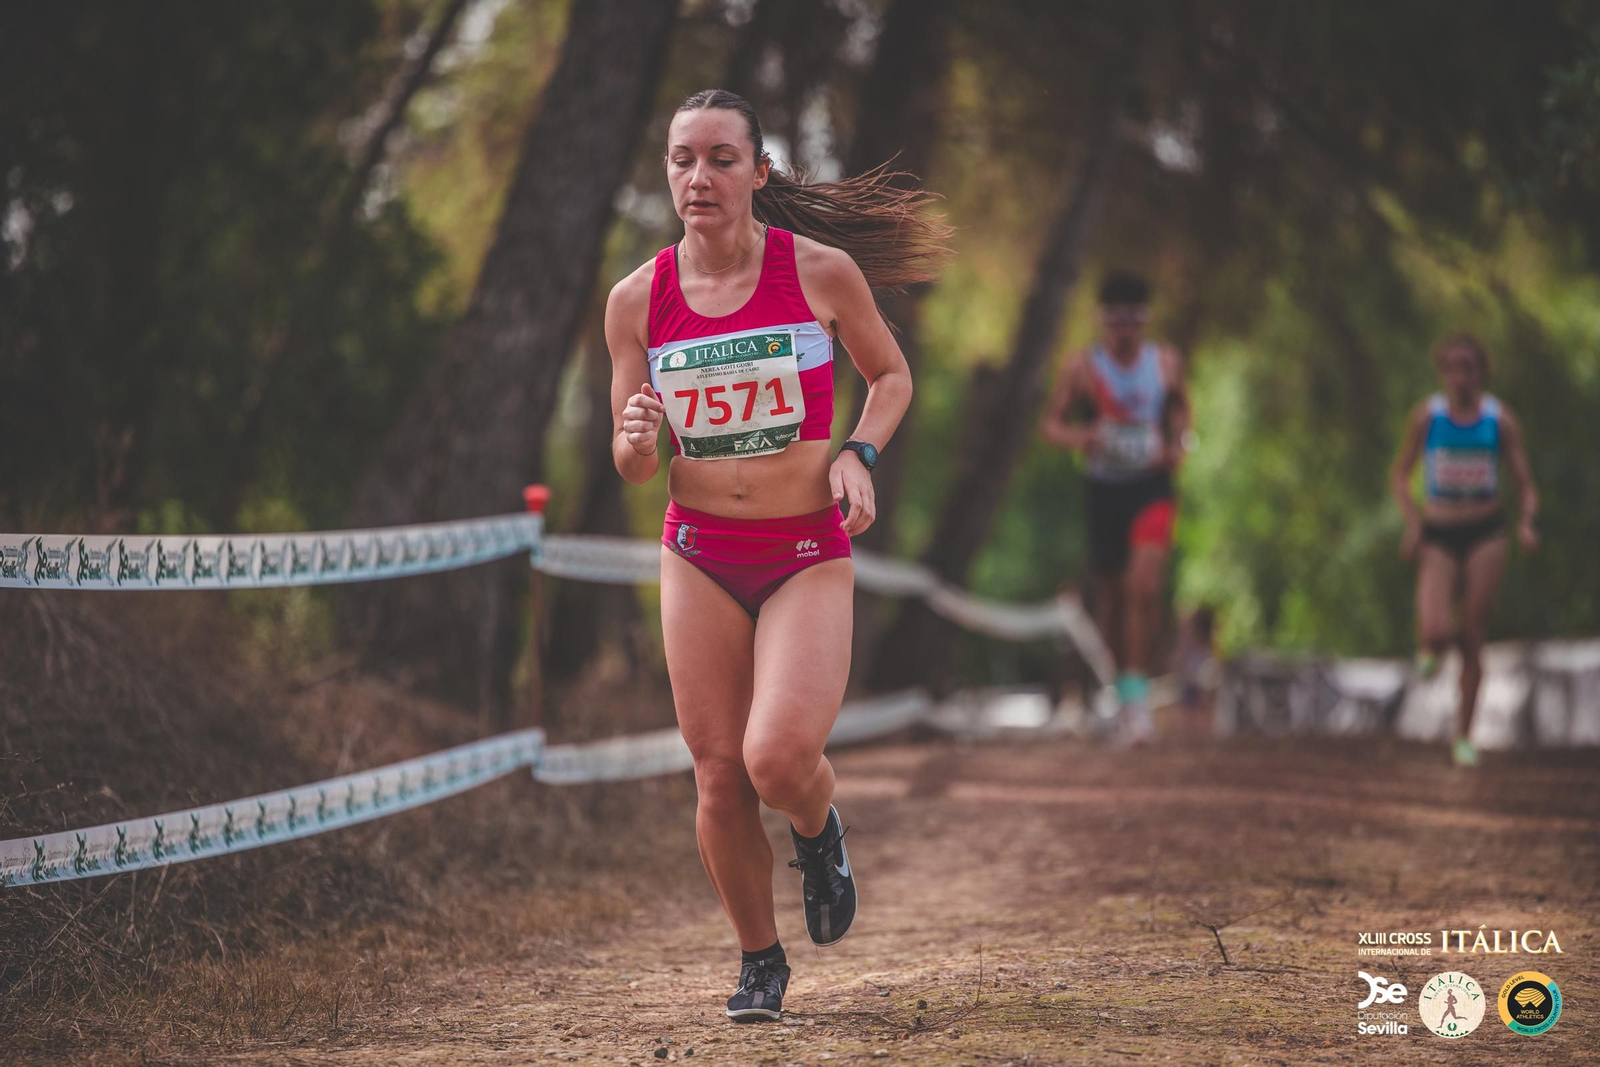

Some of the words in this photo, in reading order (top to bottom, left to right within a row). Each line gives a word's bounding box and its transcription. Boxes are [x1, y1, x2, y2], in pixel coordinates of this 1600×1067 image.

[695, 340, 758, 361] ITÁLICA
[674, 377, 794, 428] 7571
[797, 550, 819, 558] mobel
